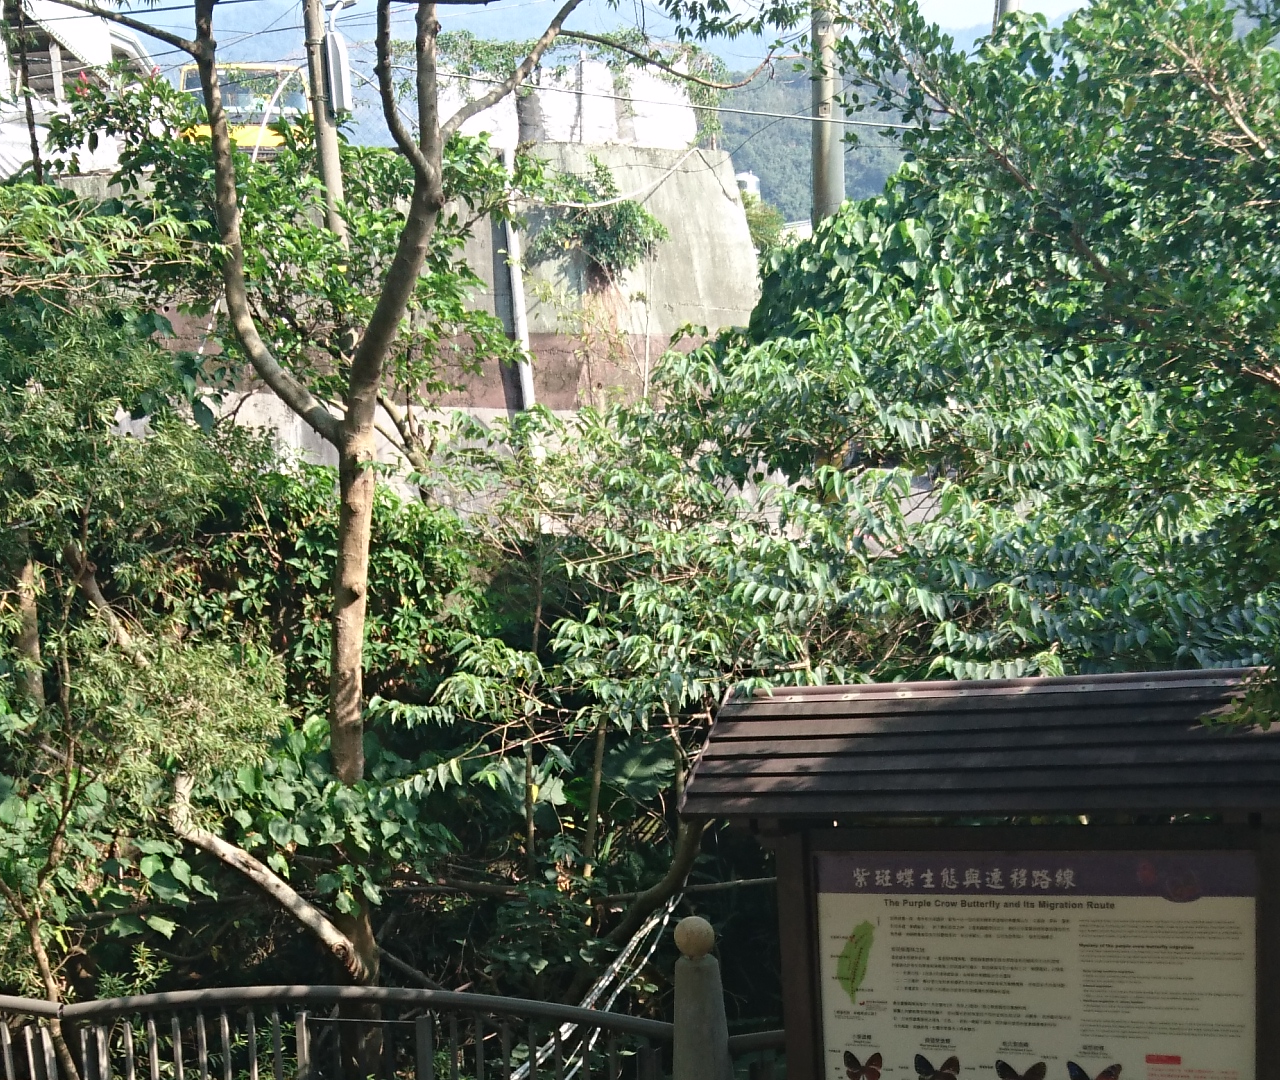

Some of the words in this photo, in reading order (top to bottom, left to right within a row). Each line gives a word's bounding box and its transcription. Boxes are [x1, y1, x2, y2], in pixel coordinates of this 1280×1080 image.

[852, 867, 1076, 890] 紫斑蝶生態與遷移路線
[884, 898, 900, 907] The
[902, 899, 931, 909] Purple
[934, 899, 958, 908] Crow
[960, 900, 1001, 910] Butterfly
[1003, 901, 1020, 909] and
[1023, 901, 1035, 909] Its
[1038, 901, 1084, 911] Migration
[1086, 902, 1116, 910] Route
